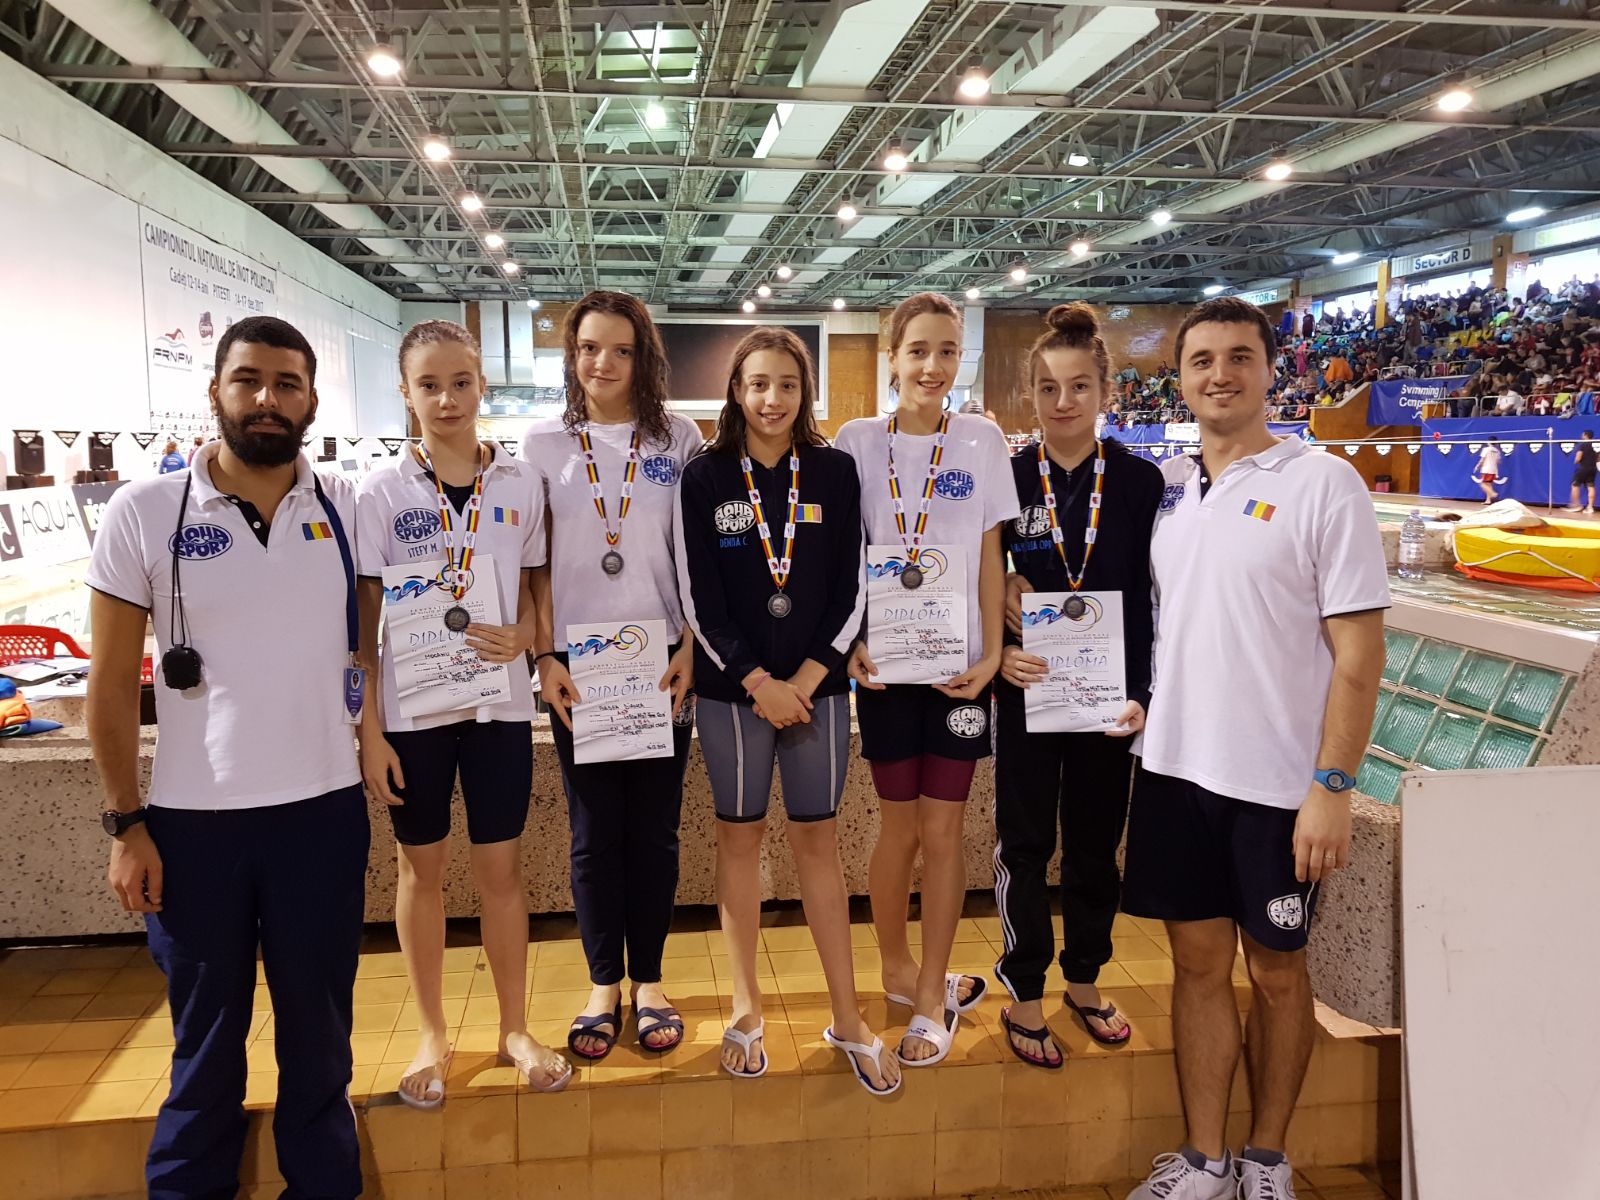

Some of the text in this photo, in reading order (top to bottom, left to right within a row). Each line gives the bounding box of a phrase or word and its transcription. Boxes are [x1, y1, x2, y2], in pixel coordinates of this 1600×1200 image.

[144, 222, 196, 262] CAMPIONATUL
[228, 258, 236, 279] DE
[1463, 248, 1471, 260] D
[22, 499, 81, 536] AQUA
[715, 503, 755, 520] AQUA
[395, 511, 441, 531] AQUA
[715, 517, 754, 532] SPORT
[396, 523, 439, 541] SPORT
[884, 607, 951, 621] DIPLOMA
[409, 629, 464, 647] DIPLO
[587, 682, 654, 699] DIPLOMA
